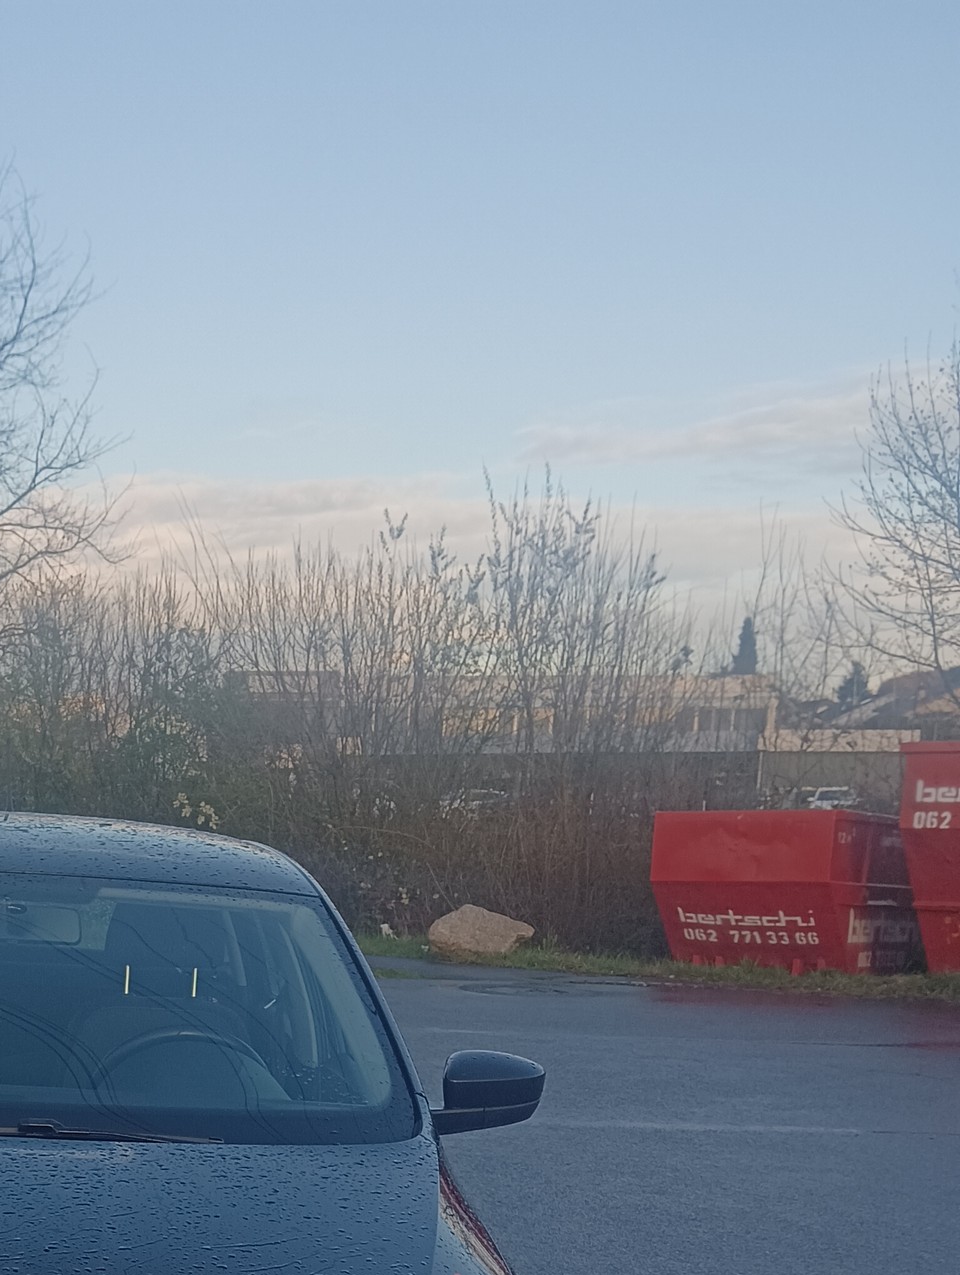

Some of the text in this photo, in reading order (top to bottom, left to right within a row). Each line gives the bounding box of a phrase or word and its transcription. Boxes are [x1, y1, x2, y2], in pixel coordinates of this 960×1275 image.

[915, 779, 960, 803] be
[912, 811, 952, 829] 062
[677, 906, 816, 927] bertschi
[683, 928, 820, 945] 062 771 33 66
